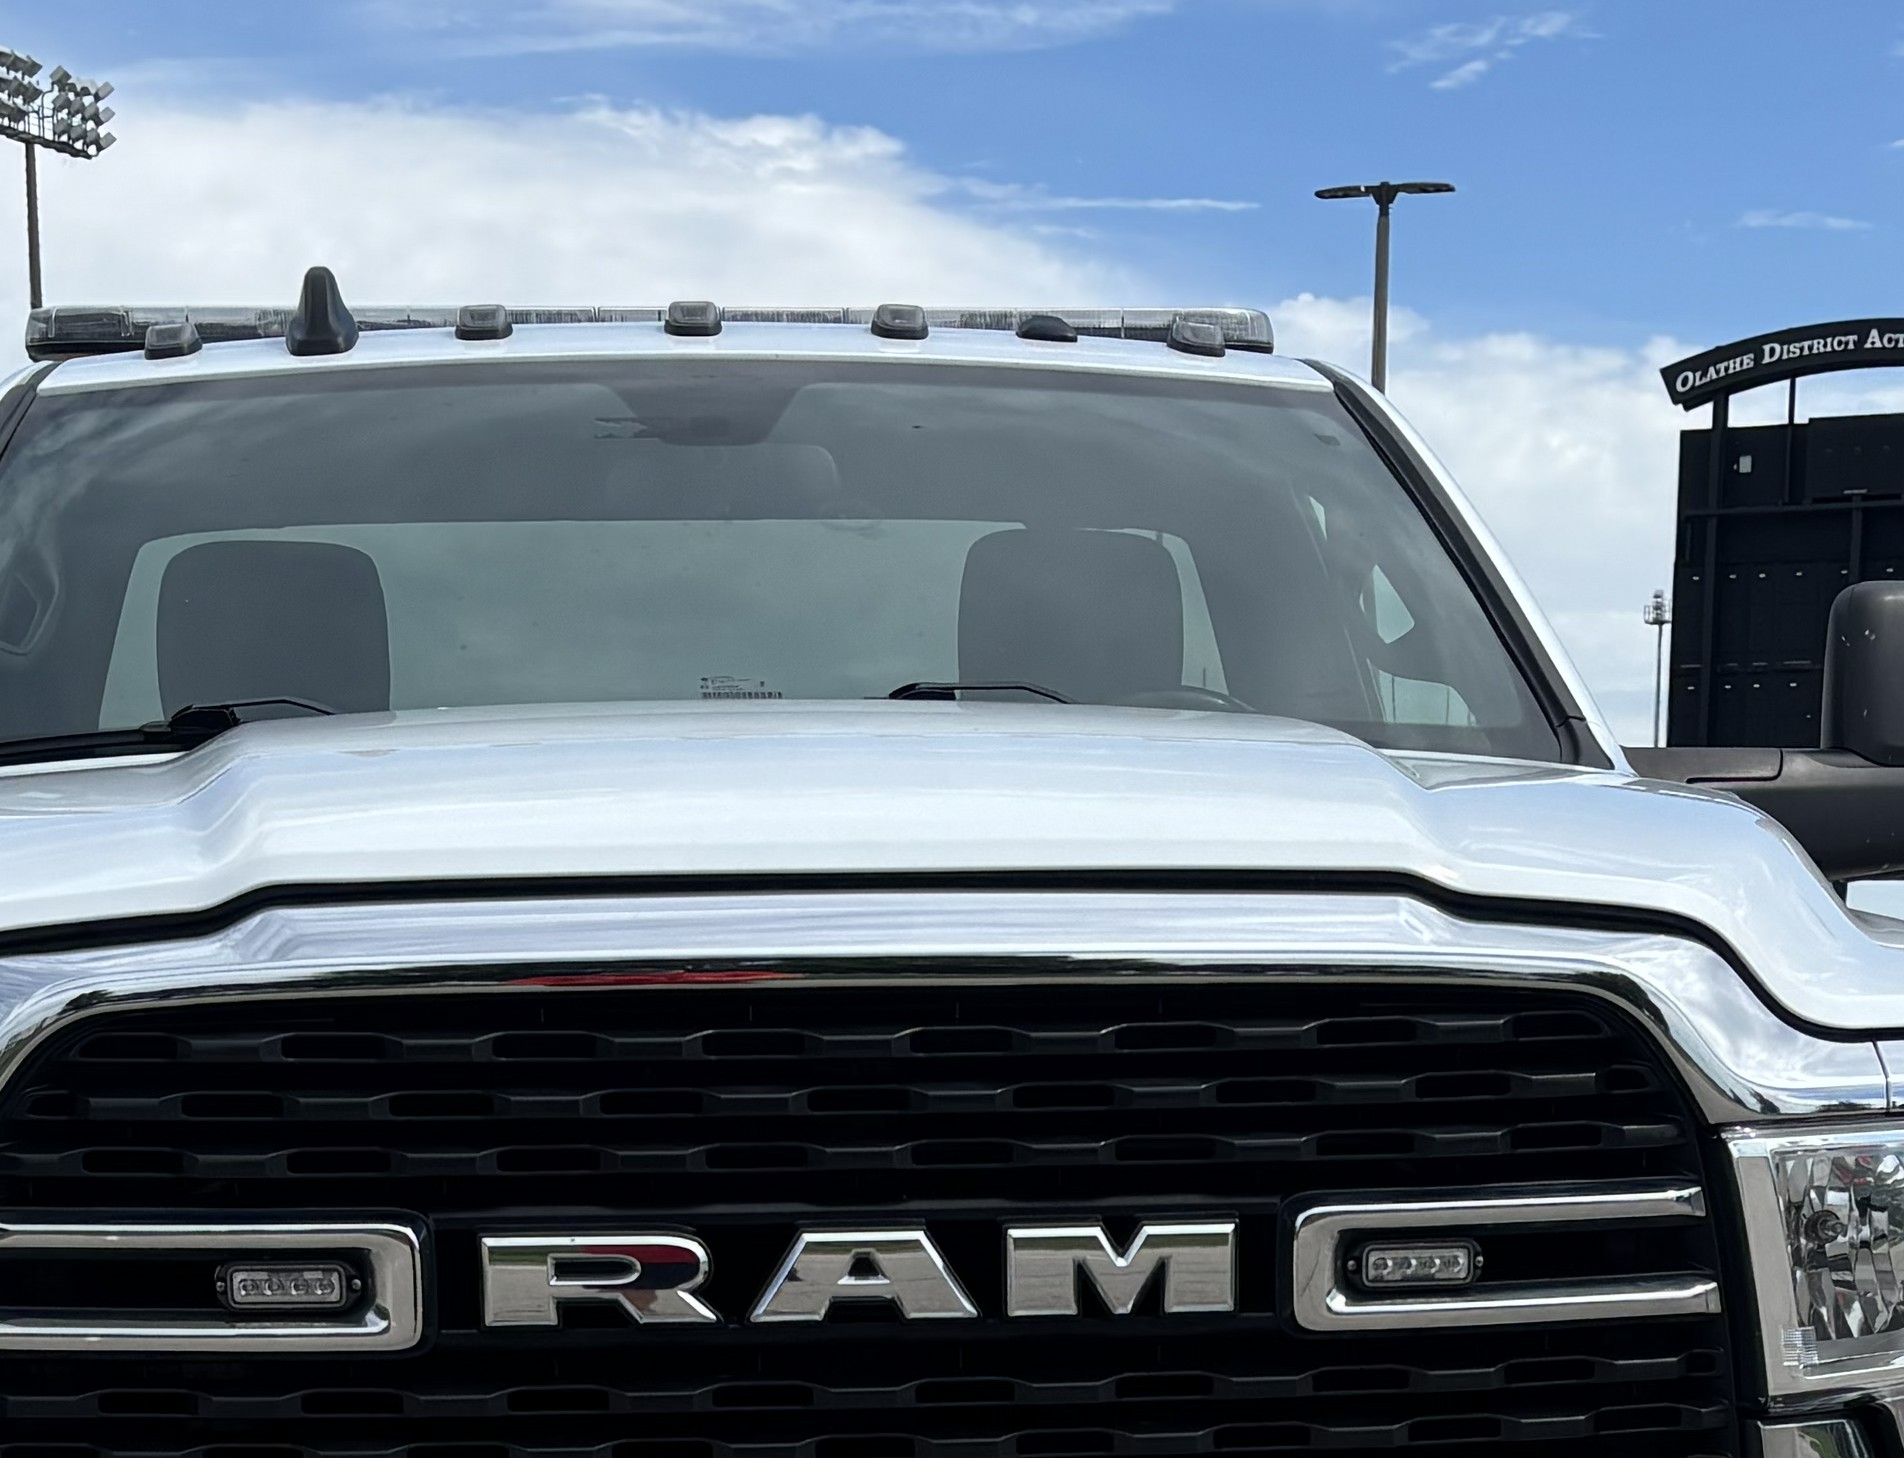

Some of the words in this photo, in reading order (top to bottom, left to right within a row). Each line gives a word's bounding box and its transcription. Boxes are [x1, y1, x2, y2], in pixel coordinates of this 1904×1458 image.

[1675, 353, 1755, 393] OLATHE
[1761, 334, 1858, 365] DISTRICT
[480, 1221, 1237, 1327] RAM
